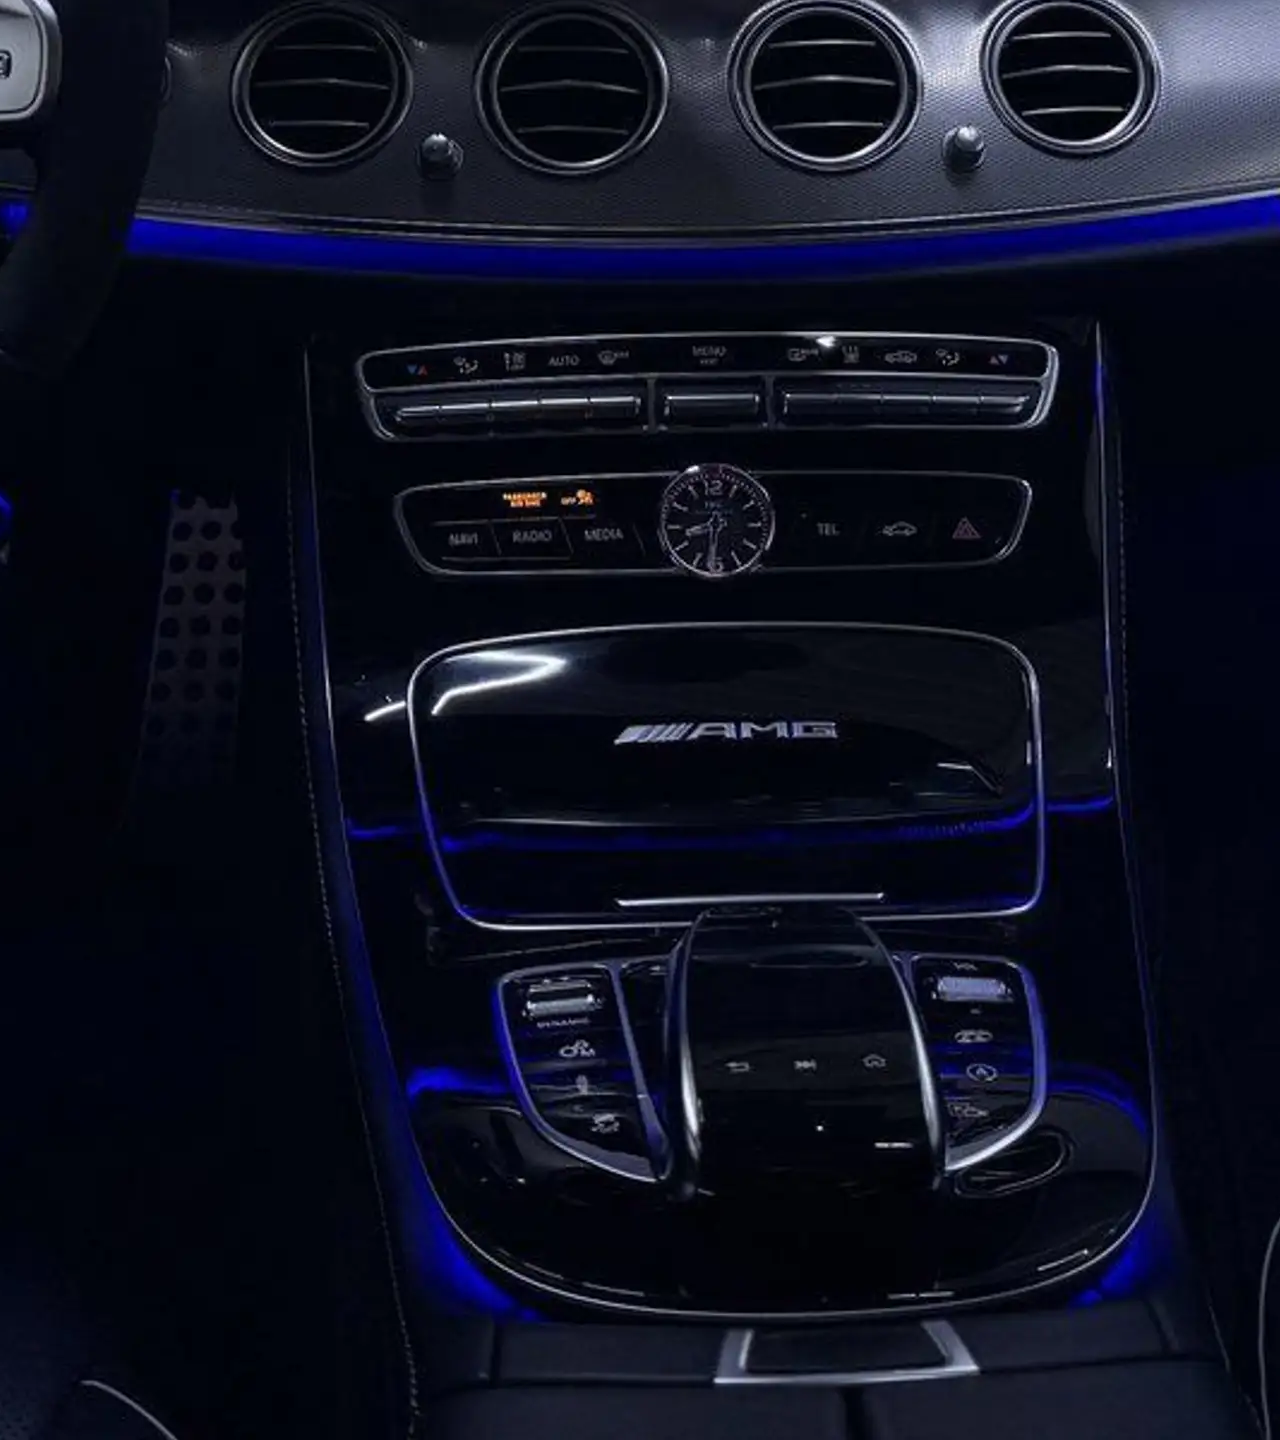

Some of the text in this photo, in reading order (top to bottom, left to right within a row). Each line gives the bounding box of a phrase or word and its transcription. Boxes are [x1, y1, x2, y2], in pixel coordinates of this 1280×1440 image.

[549, 355, 580, 366] AUTO
[704, 479, 723, 496] 12
[584, 529, 624, 541] MEDIA
[817, 523, 841, 536] TEL
[513, 530, 552, 543] RADIO
[686, 721, 838, 741] AMG
